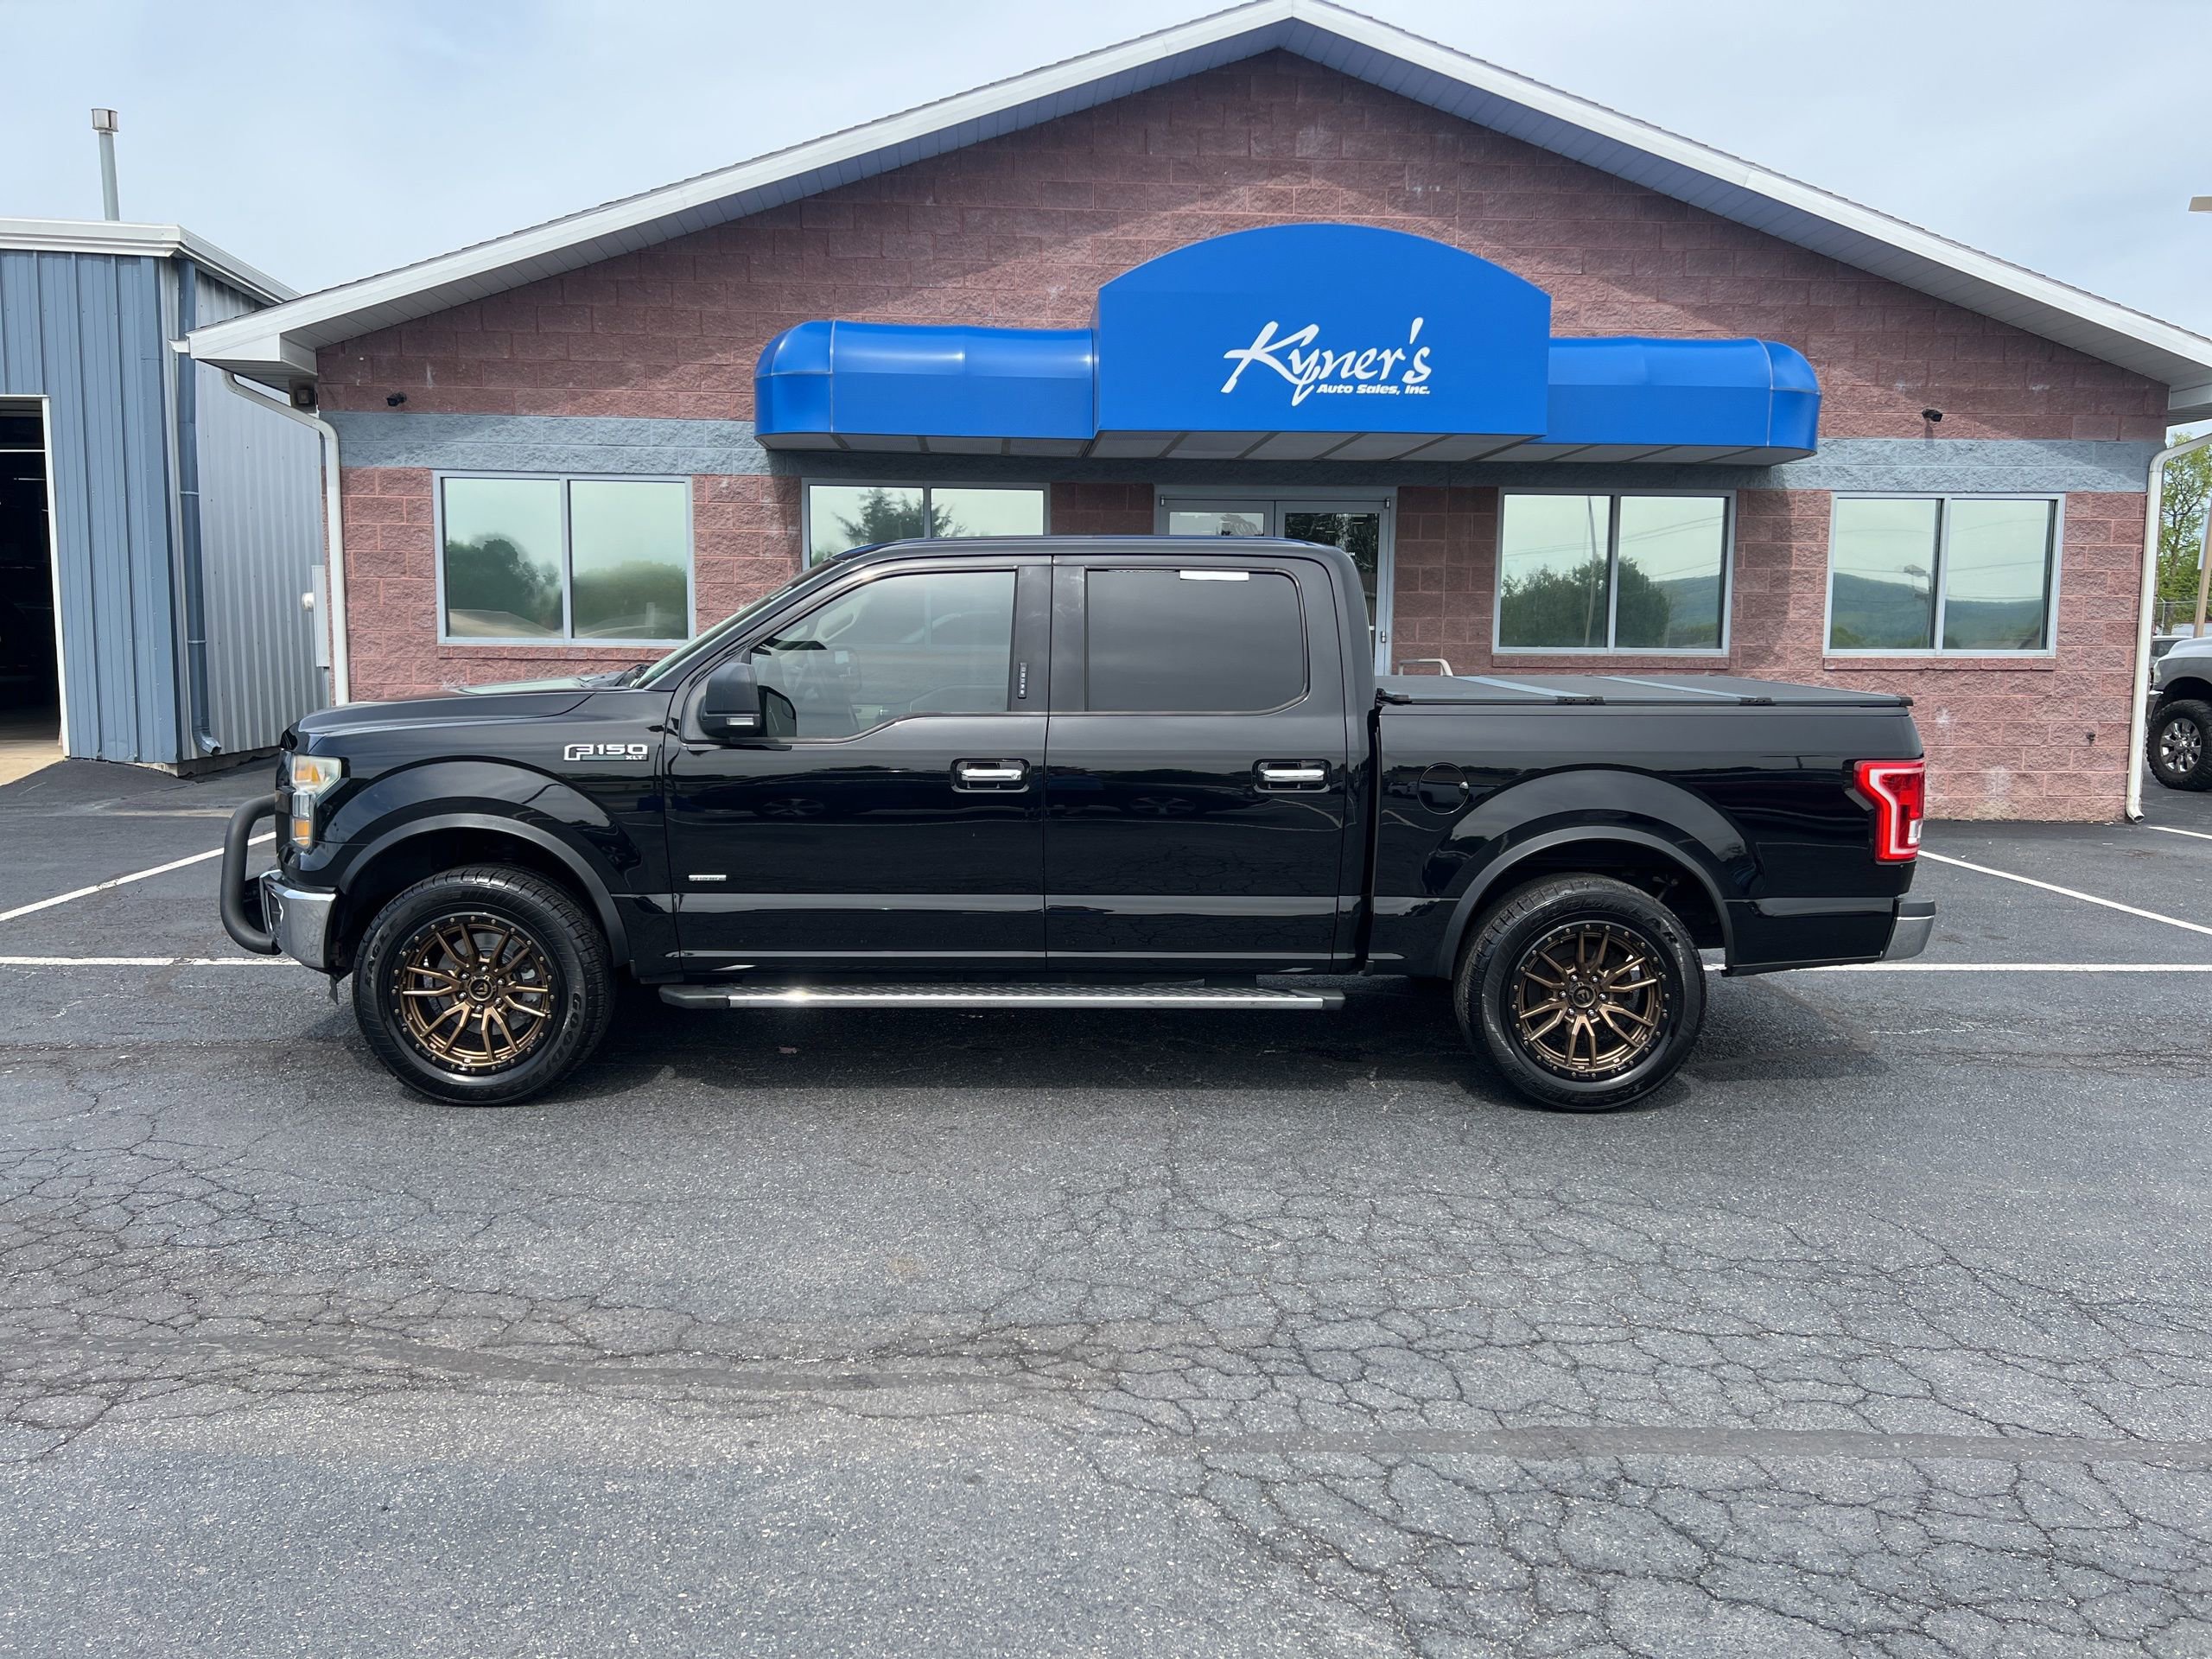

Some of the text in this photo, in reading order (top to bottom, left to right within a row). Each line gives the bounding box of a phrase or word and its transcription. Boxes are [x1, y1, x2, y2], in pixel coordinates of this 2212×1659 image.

[1221, 316, 1432, 407] Kyner's
[1316, 384, 1431, 396] Auto Sales, Inc.
